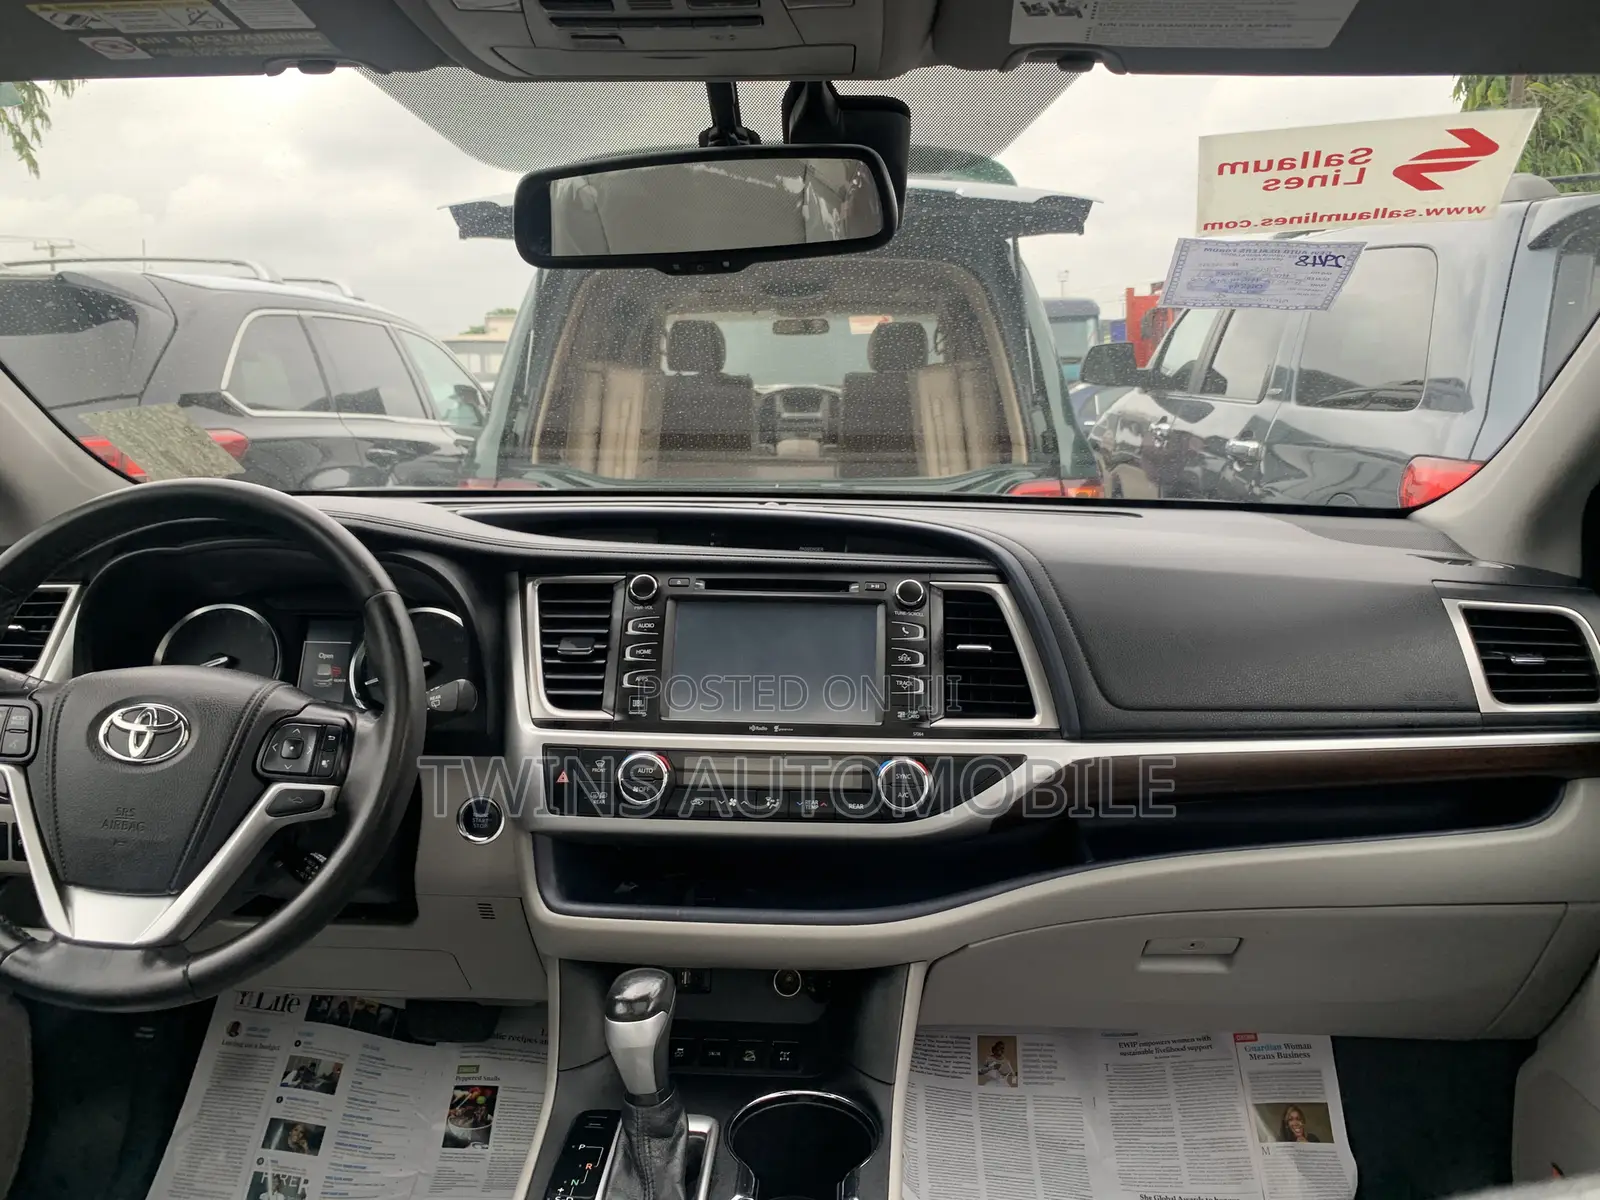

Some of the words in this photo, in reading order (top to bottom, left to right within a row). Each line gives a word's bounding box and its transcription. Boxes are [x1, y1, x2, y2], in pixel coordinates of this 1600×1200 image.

[115, 806, 136, 817] SRS
[101, 818, 146, 832] AIRBAG
[1139, 1039, 1171, 1048] empowers
[1244, 1043, 1282, 1052] Guardian
[1283, 1042, 1312, 1050] Woman
[1119, 1048, 1154, 1056] sustainable
[1155, 1045, 1186, 1054] livelihood
[1187, 1043, 1213, 1052] support
[1249, 1052, 1275, 1061] Means
[1276, 1051, 1311, 1060] Business
[578, 1143, 586, 1151] P
[585, 1162, 593, 1170] R
